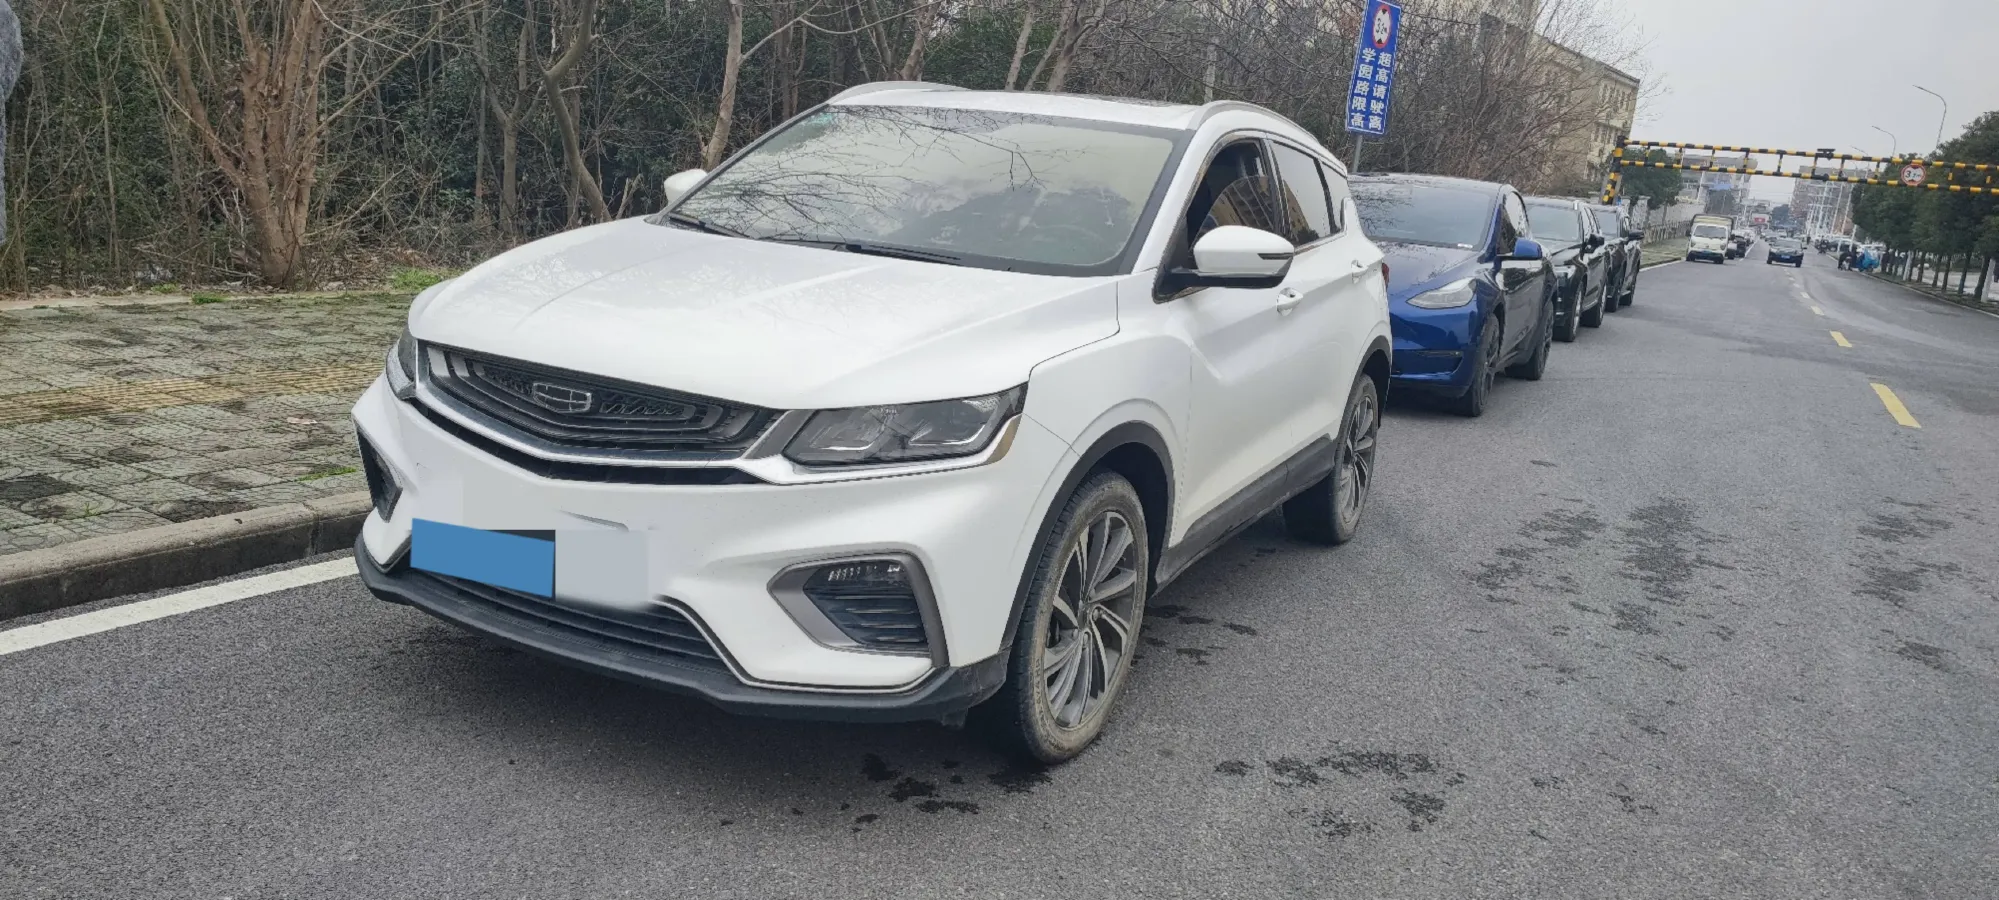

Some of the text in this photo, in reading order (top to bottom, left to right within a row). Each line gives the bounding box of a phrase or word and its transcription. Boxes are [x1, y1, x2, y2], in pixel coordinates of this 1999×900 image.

[1351, 47, 1376, 128] 学园路限高
[1368, 52, 1392, 130] 超高请驶离
